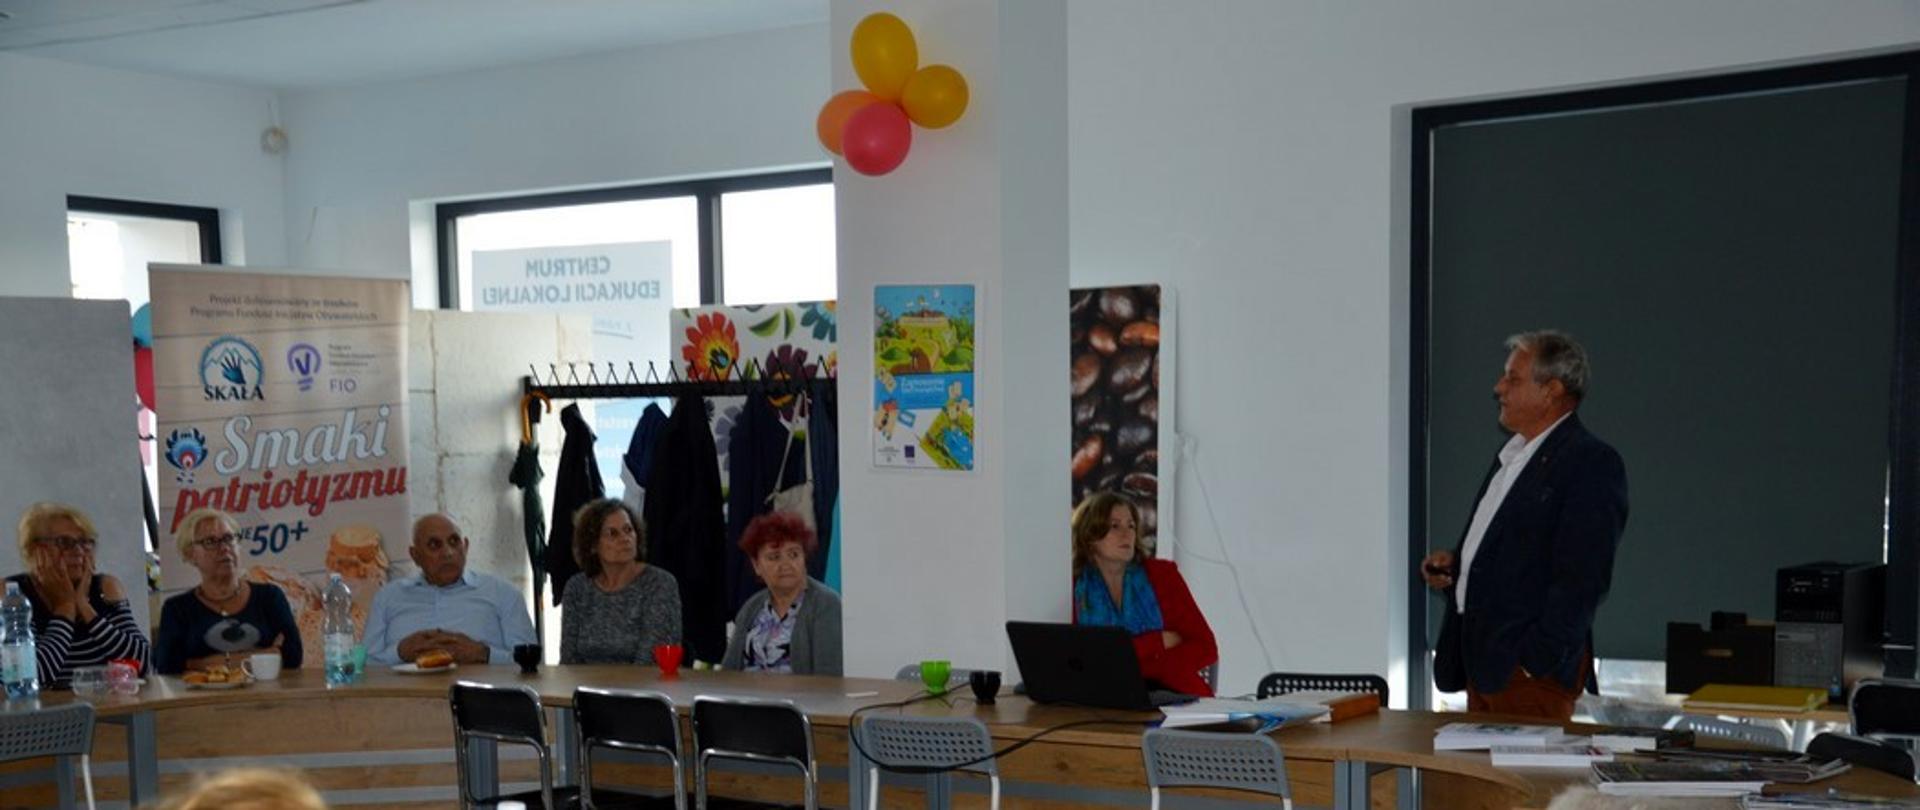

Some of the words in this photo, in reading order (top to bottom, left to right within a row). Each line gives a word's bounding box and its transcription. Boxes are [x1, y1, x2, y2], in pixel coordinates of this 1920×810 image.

[204, 385, 264, 401] SKAŁA
[329, 378, 357, 393] FIO
[214, 404, 390, 475] Smaki
[170, 466, 407, 534] patriotyzmu
[249, 520, 309, 556] 50+
